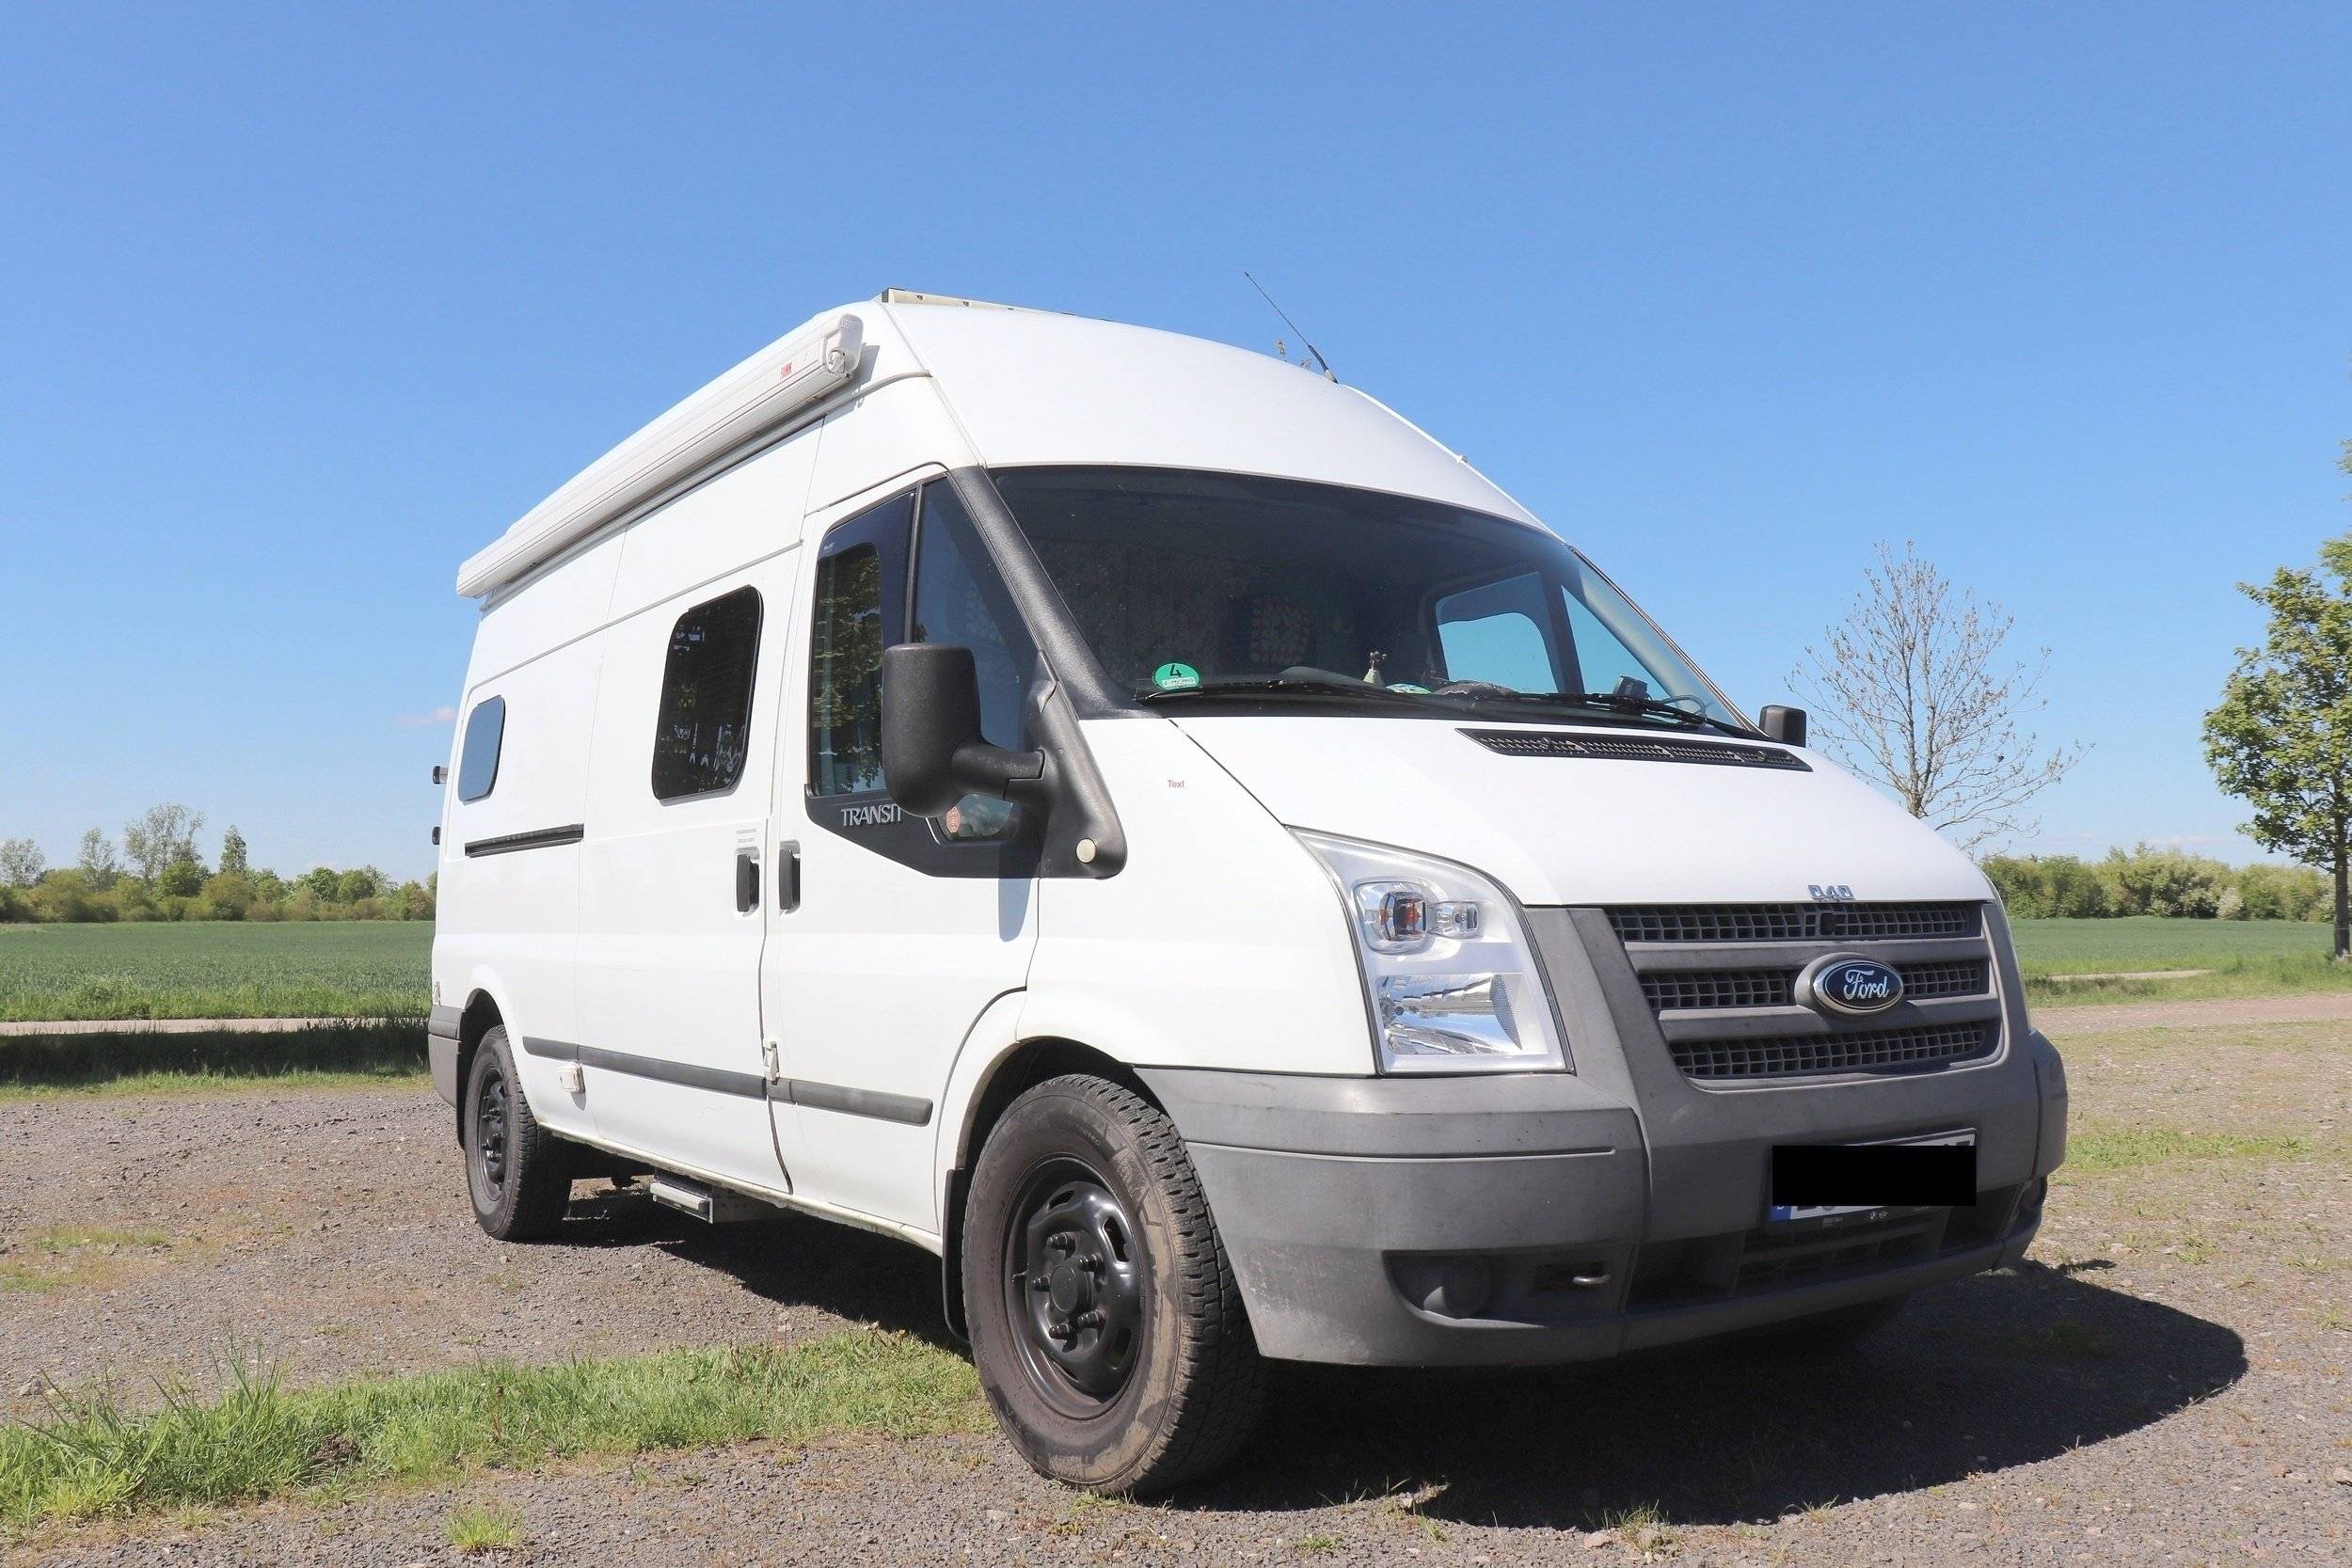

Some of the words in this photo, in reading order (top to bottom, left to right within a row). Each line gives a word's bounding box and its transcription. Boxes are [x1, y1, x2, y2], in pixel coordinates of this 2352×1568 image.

[1169, 663, 1182, 677] 4
[840, 802, 901, 827] TRANSIT
[1844, 969, 1889, 1000] Ford
